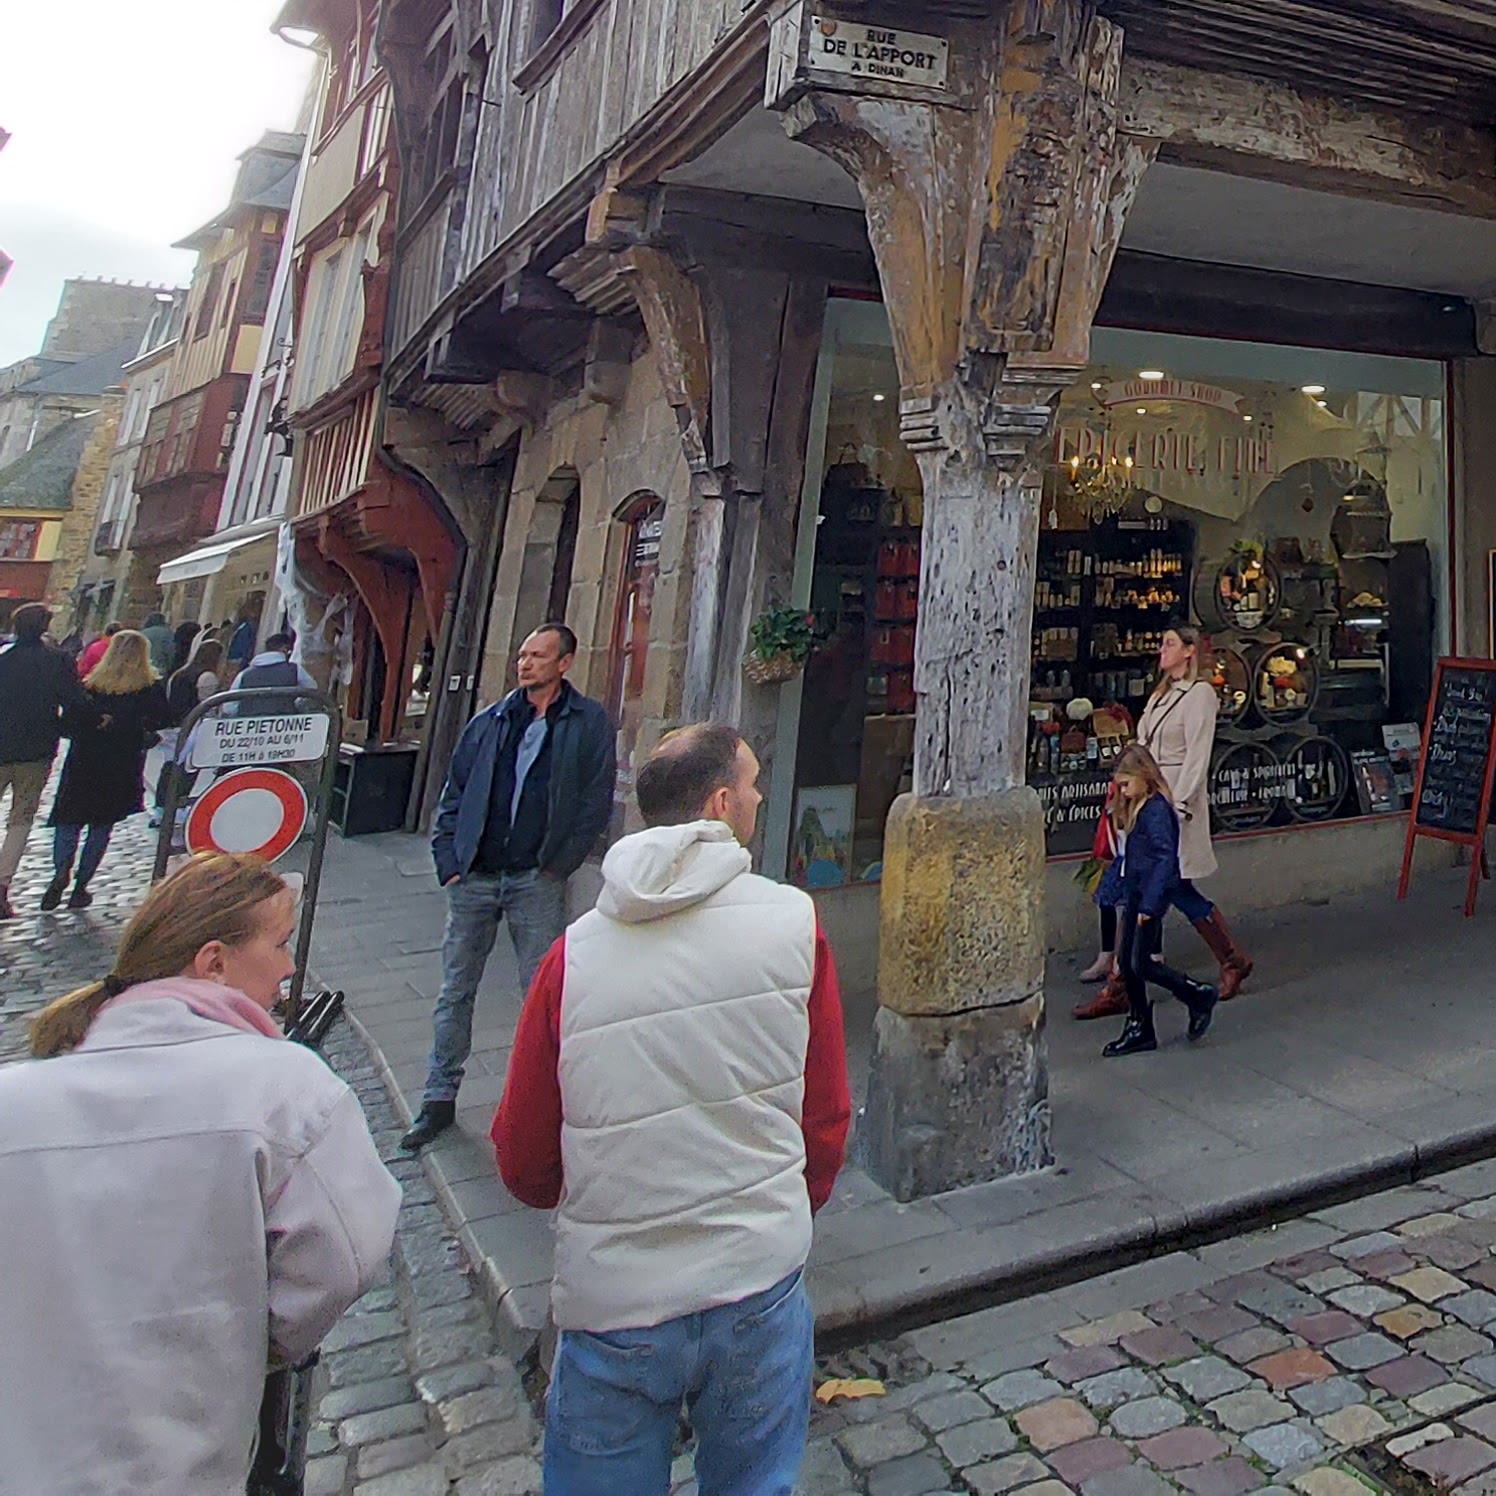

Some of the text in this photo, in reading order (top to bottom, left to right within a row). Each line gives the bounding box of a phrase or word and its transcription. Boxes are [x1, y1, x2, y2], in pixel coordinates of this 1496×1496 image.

[866, 29, 897, 45] RUE
[823, 38, 937, 70] DE L'APPORT
[868, 63, 904, 78] DINAN
[215, 716, 312, 736] RUE PIETONNE
[219, 733, 304, 749] DU 22/10 AU 6/11
[221, 752, 236, 763] DE
[238, 750, 256, 761] 11H
